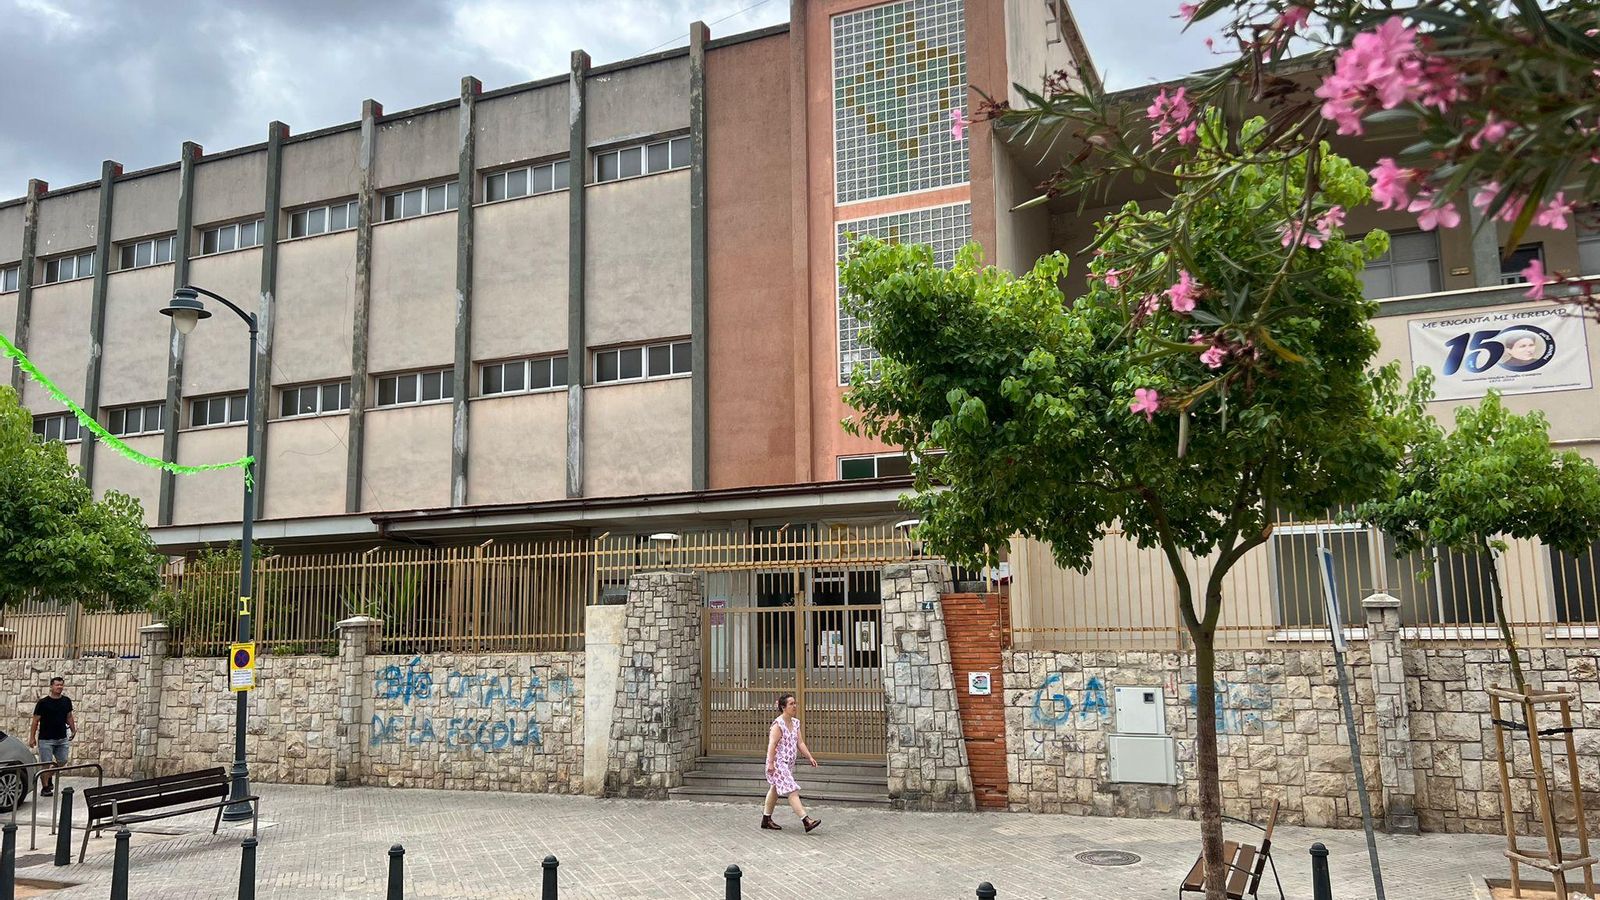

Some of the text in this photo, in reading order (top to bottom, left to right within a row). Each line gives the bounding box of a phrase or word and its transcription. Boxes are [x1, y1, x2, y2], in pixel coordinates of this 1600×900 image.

[1422, 321, 1437, 329] ME
[1440, 316, 1490, 327] ENCANTA
[1512, 308, 1567, 319] HEREDAD
[1442, 324, 1556, 376] 150
